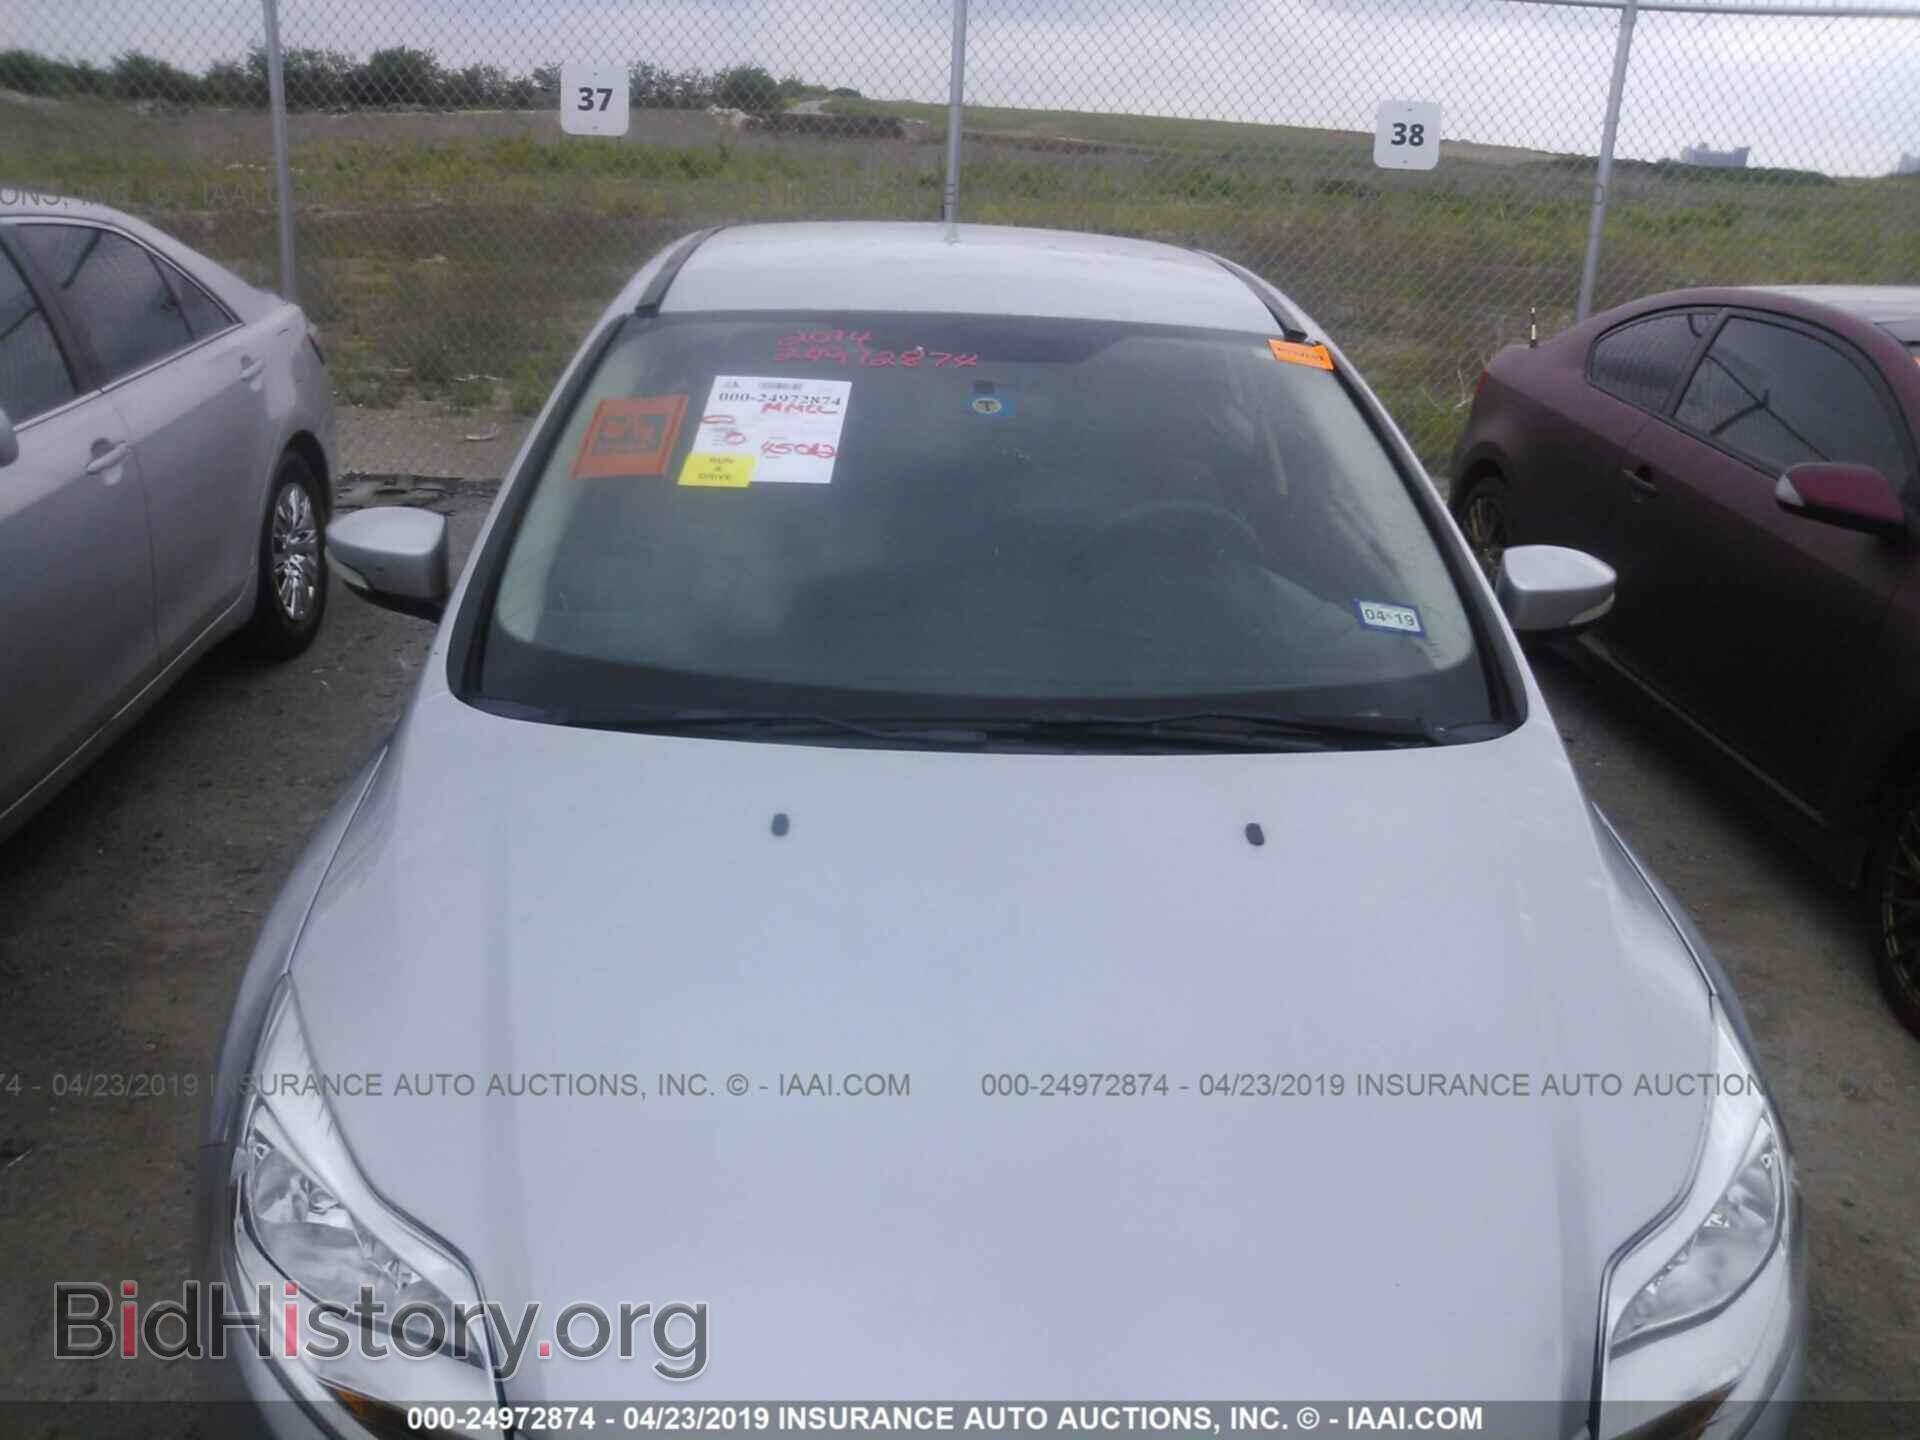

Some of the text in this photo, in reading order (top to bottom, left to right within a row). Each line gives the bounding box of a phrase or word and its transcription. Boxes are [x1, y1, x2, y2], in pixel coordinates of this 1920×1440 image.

[576, 86, 614, 112] 37
[1390, 121, 1426, 147] 38
[718, 392, 842, 407] 000-24972874
